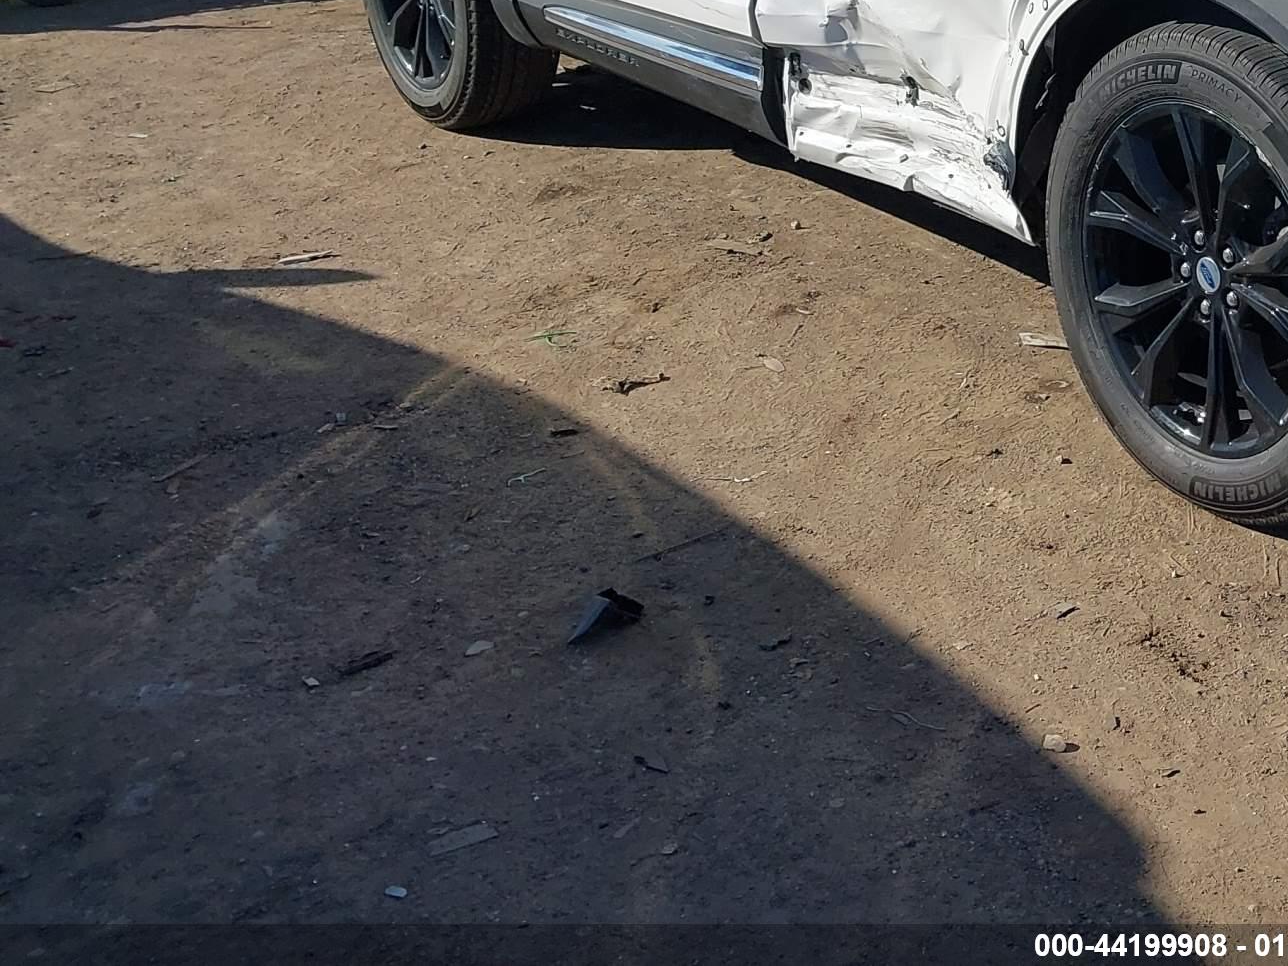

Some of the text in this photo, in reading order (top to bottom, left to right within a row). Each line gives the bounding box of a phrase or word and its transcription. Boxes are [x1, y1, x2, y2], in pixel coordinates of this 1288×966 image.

[1101, 63, 1178, 97] MICHELIN
[1191, 68, 1243, 103] PRIMACY
[1193, 474, 1281, 502] MICHELIN
